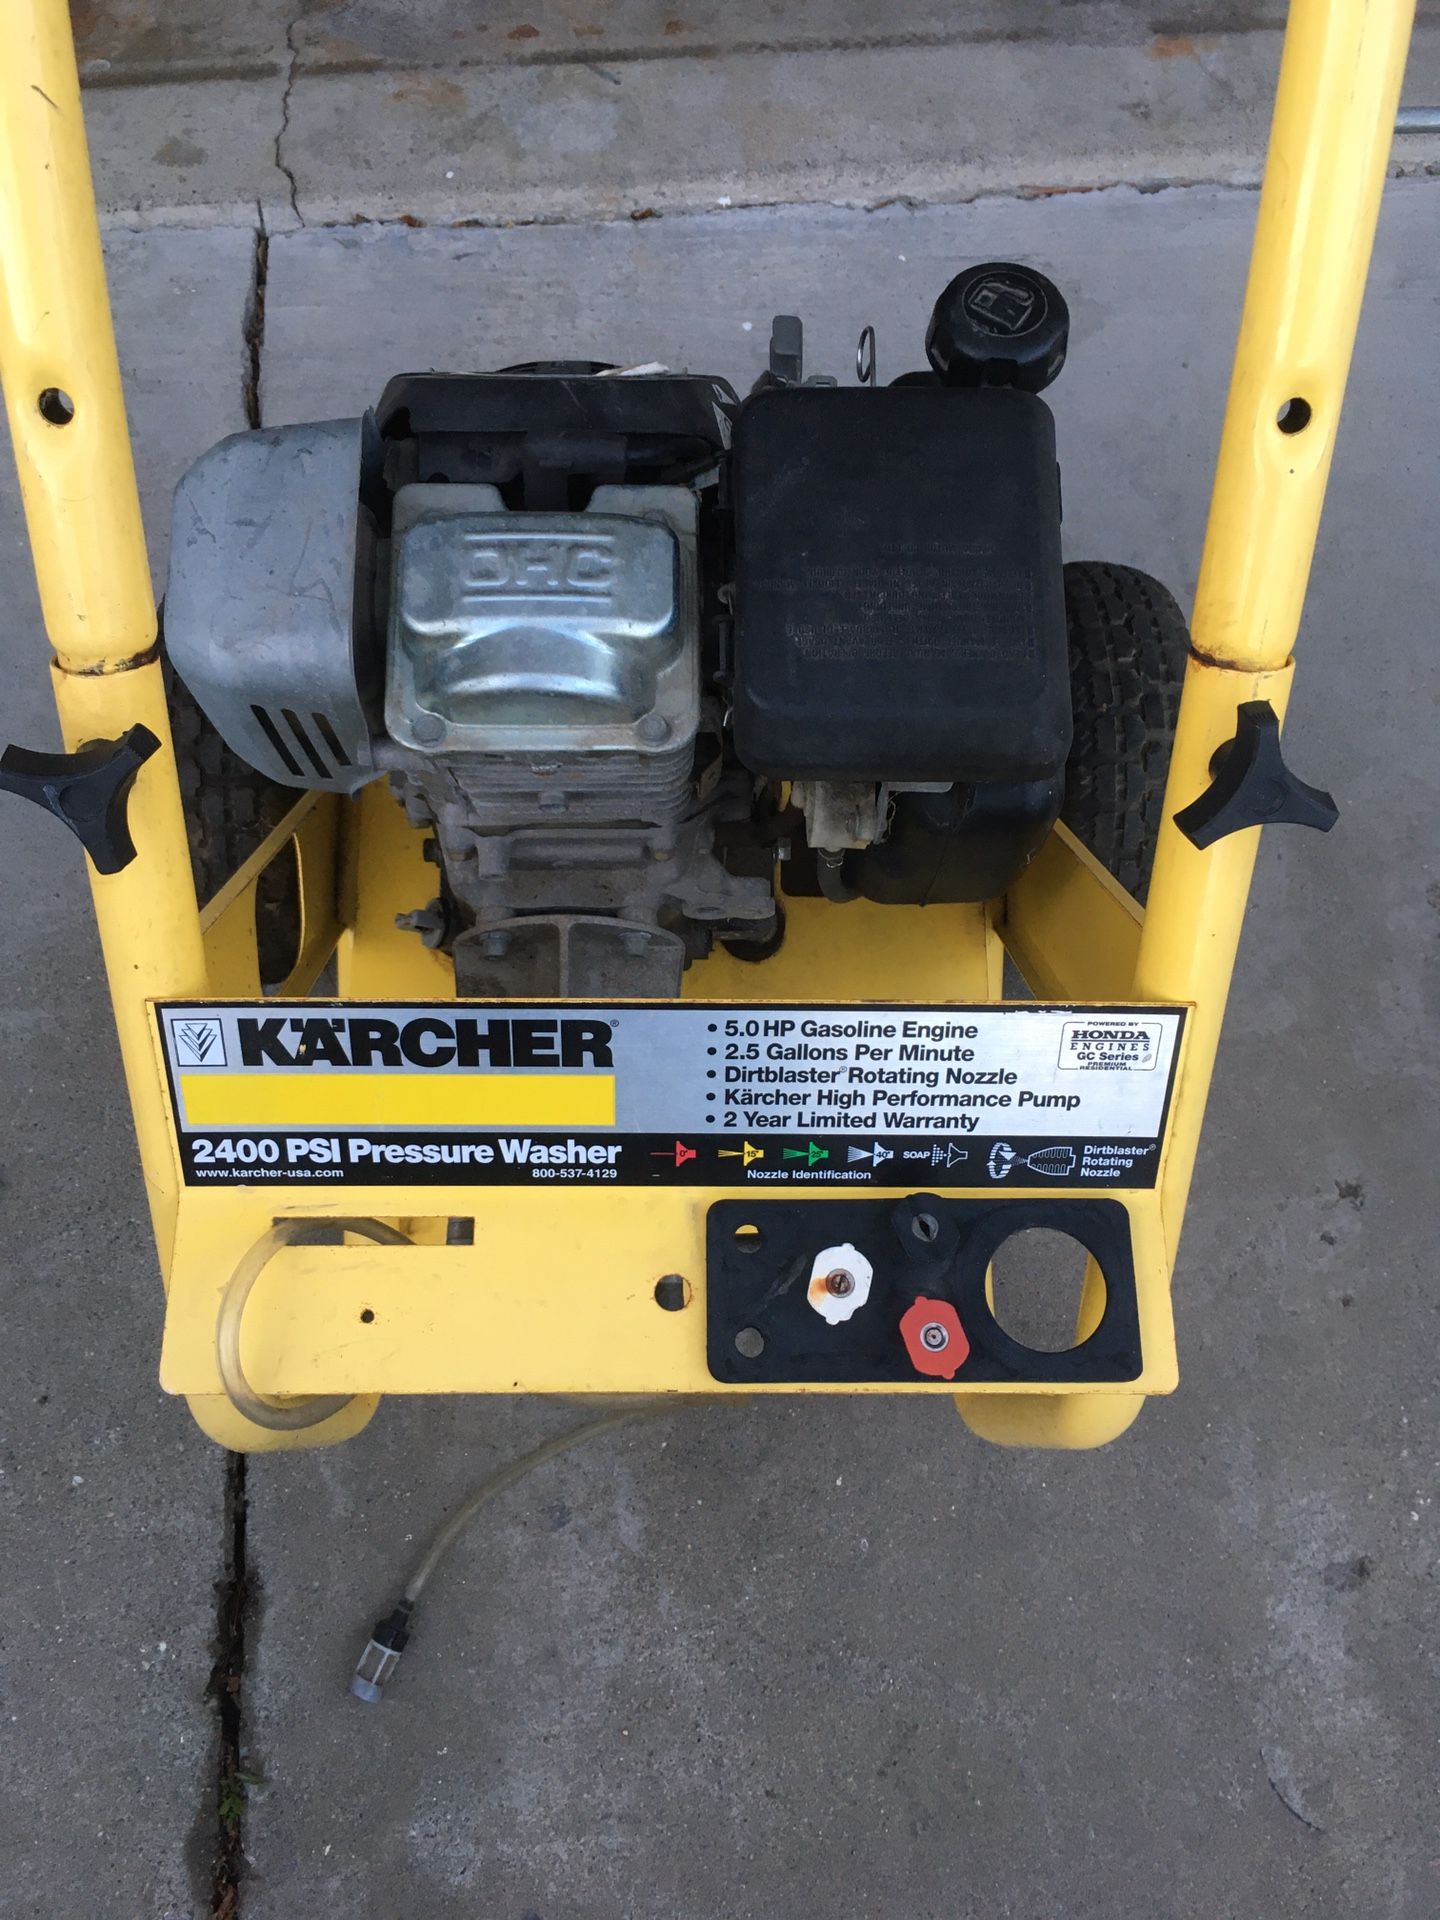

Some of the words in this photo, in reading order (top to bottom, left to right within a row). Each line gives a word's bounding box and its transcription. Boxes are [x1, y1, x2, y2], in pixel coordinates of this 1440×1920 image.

[724, 1020, 760, 1037] 5.0
[763, 1020, 795, 1037] HP
[800, 1021, 897, 1038] Gasoline
[902, 1021, 978, 1042] Engine
[1071, 1030, 1150, 1040] HONDA
[1070, 1042, 1150, 1051] ENGINES
[724, 1044, 760, 1060] 2.5
[766, 1044, 848, 1061] Gallons
[854, 1045, 893, 1061] Per
[898, 1045, 975, 1062] Minute
[1077, 1052, 1096, 1061] GC
[1099, 1052, 1139, 1061] Series
[848, 1067, 939, 1087] Rotating
[945, 1068, 1018, 1085] Nozzle
[724, 1089, 810, 1106] Kärcher
[816, 1089, 865, 1110] High
[872, 1090, 1012, 1108] Performance
[1017, 1091, 1081, 1112] Pump
[723, 1112, 737, 1128] 2
[743, 1112, 791, 1129] Year
[797, 1112, 876, 1129] Limited
[883, 1113, 980, 1133] Warranty
[193, 1139, 280, 1164] 2400
[285, 1140, 342, 1164] PSI
[349, 1140, 494, 1165] Pressure
[497, 1140, 622, 1165] Washer
[903, 1150, 931, 1159] SOAP
[1082, 1156, 1134, 1168] Rotating
[196, 1168, 344, 1179] www.karcher-usa.com
[532, 1168, 618, 1179] 800-537-4129
[747, 1169, 789, 1179] Nozzle
[792, 1169, 871, 1179] Identification
[1080, 1168, 1120, 1178] Nozzle
